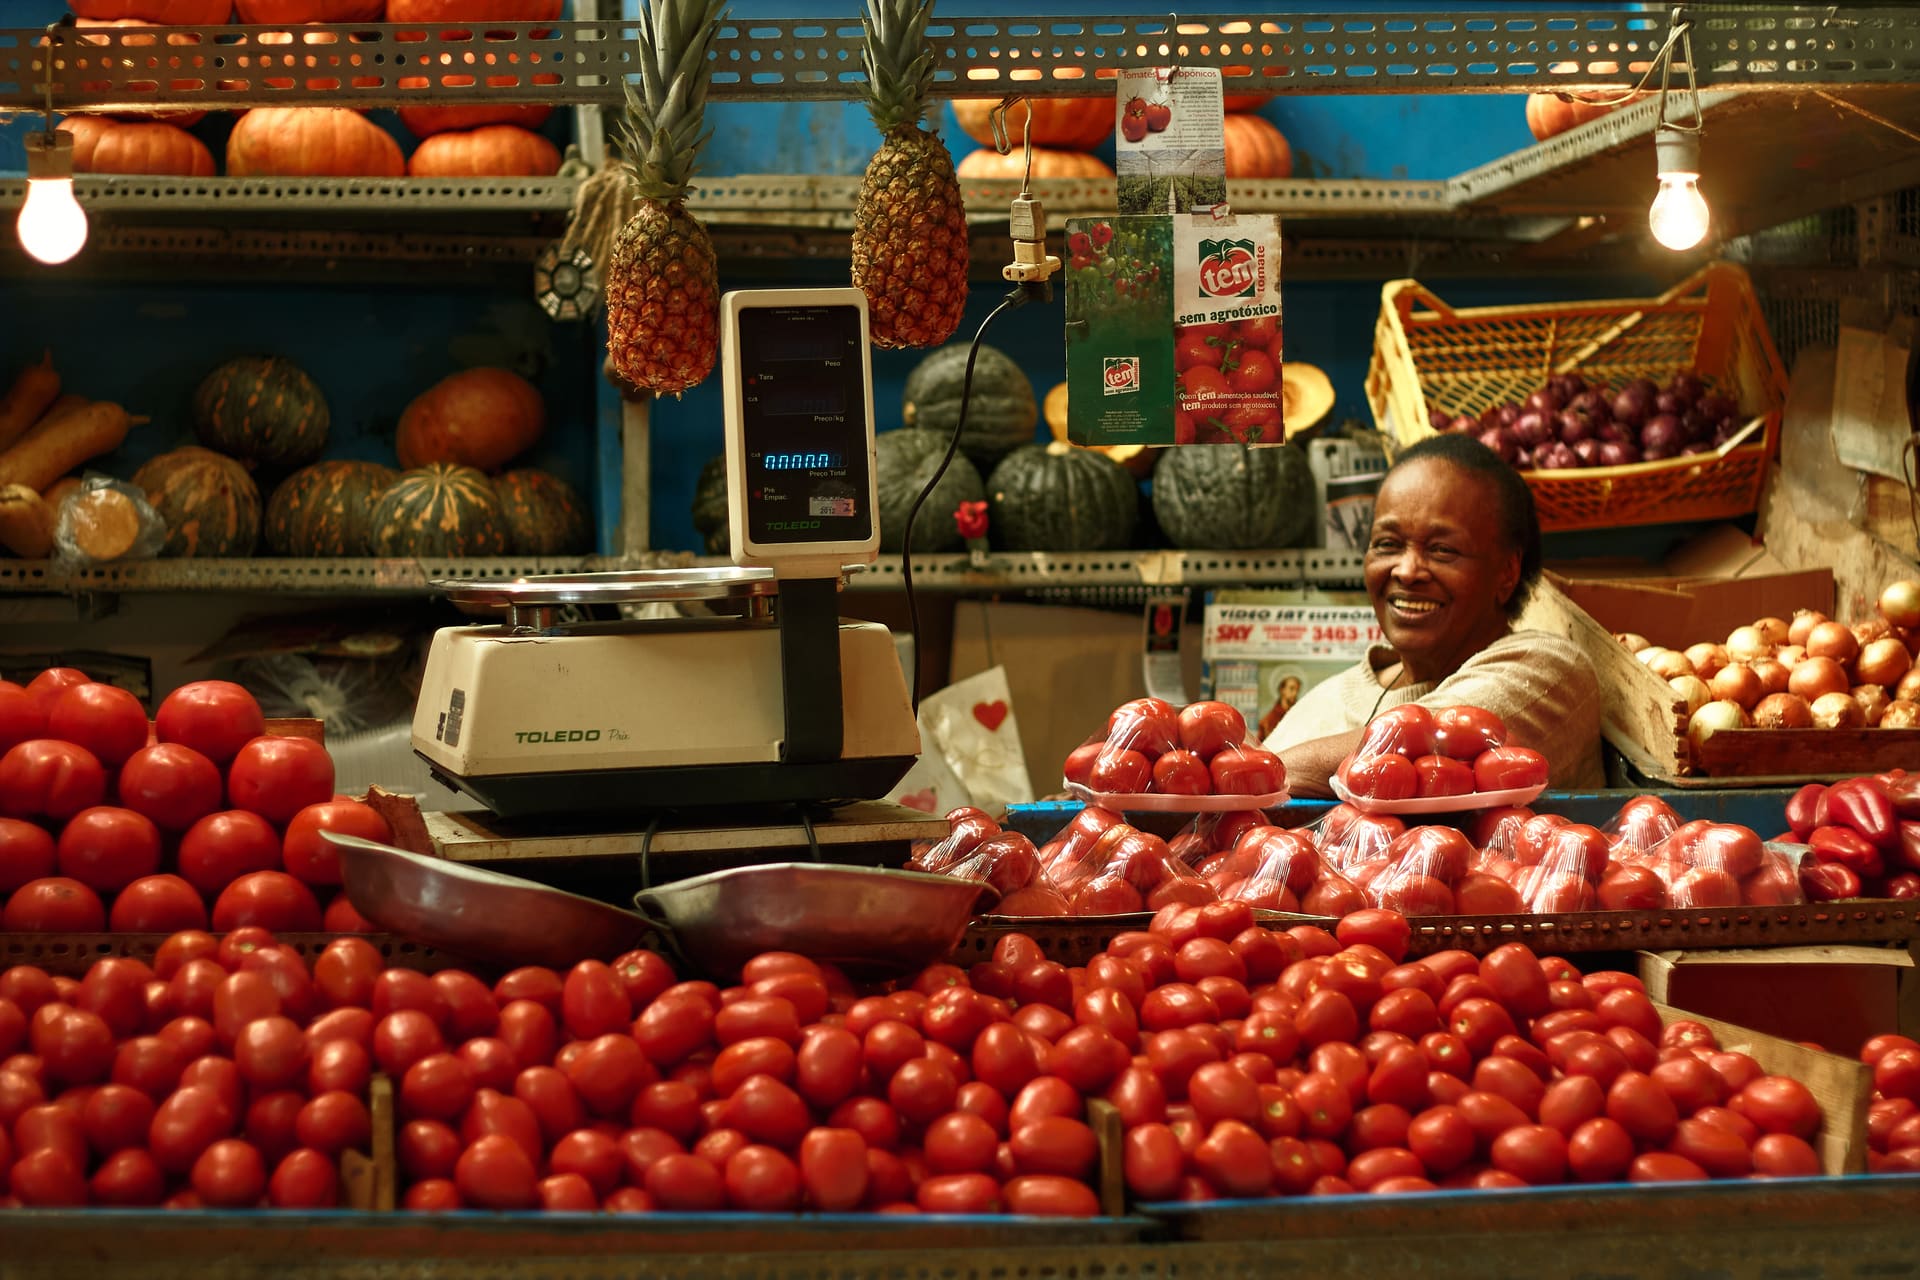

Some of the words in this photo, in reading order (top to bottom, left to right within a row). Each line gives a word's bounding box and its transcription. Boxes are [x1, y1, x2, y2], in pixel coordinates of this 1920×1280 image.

[1256, 245, 1265, 293] tomate
[1179, 311, 1206, 325] sem
[1210, 303, 1278, 324] agrotóxico
[1179, 392, 1196, 401] Quem
[1197, 391, 1217, 401] tem
[1217, 391, 1252, 401] alimentação
[1182, 401, 1201, 411] tem
[1201, 401, 1228, 411] produtos
[814, 415, 844, 423] Preço/kg
[765, 520, 822, 531] TOLEDO
[1216, 624, 1253, 642] SKY
[514, 729, 601, 744] TOLEDO
